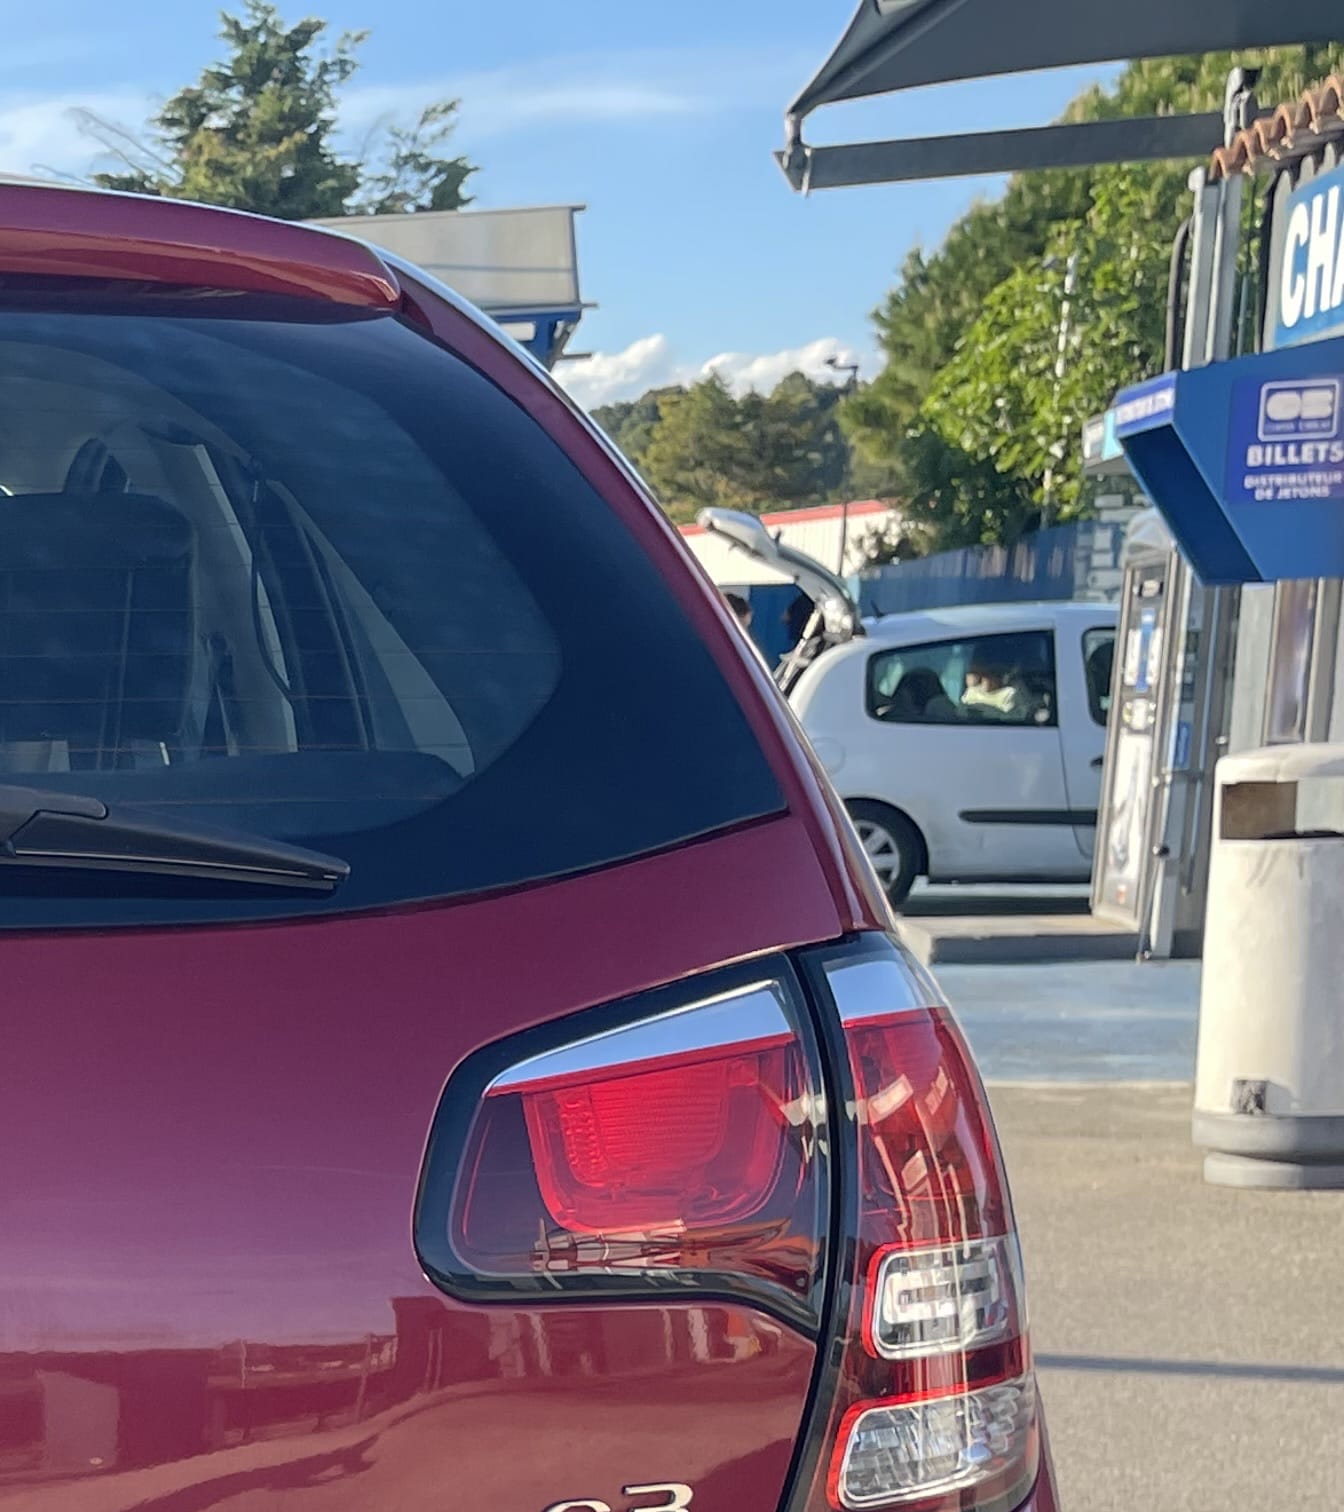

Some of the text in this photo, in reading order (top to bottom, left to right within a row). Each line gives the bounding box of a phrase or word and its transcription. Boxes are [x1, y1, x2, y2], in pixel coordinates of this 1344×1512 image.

[1247, 441, 1344, 467] BILLETS
[1244, 471, 1342, 490] DISTRIBUTEUR
[1255, 486, 1329, 500] DE JETONS
